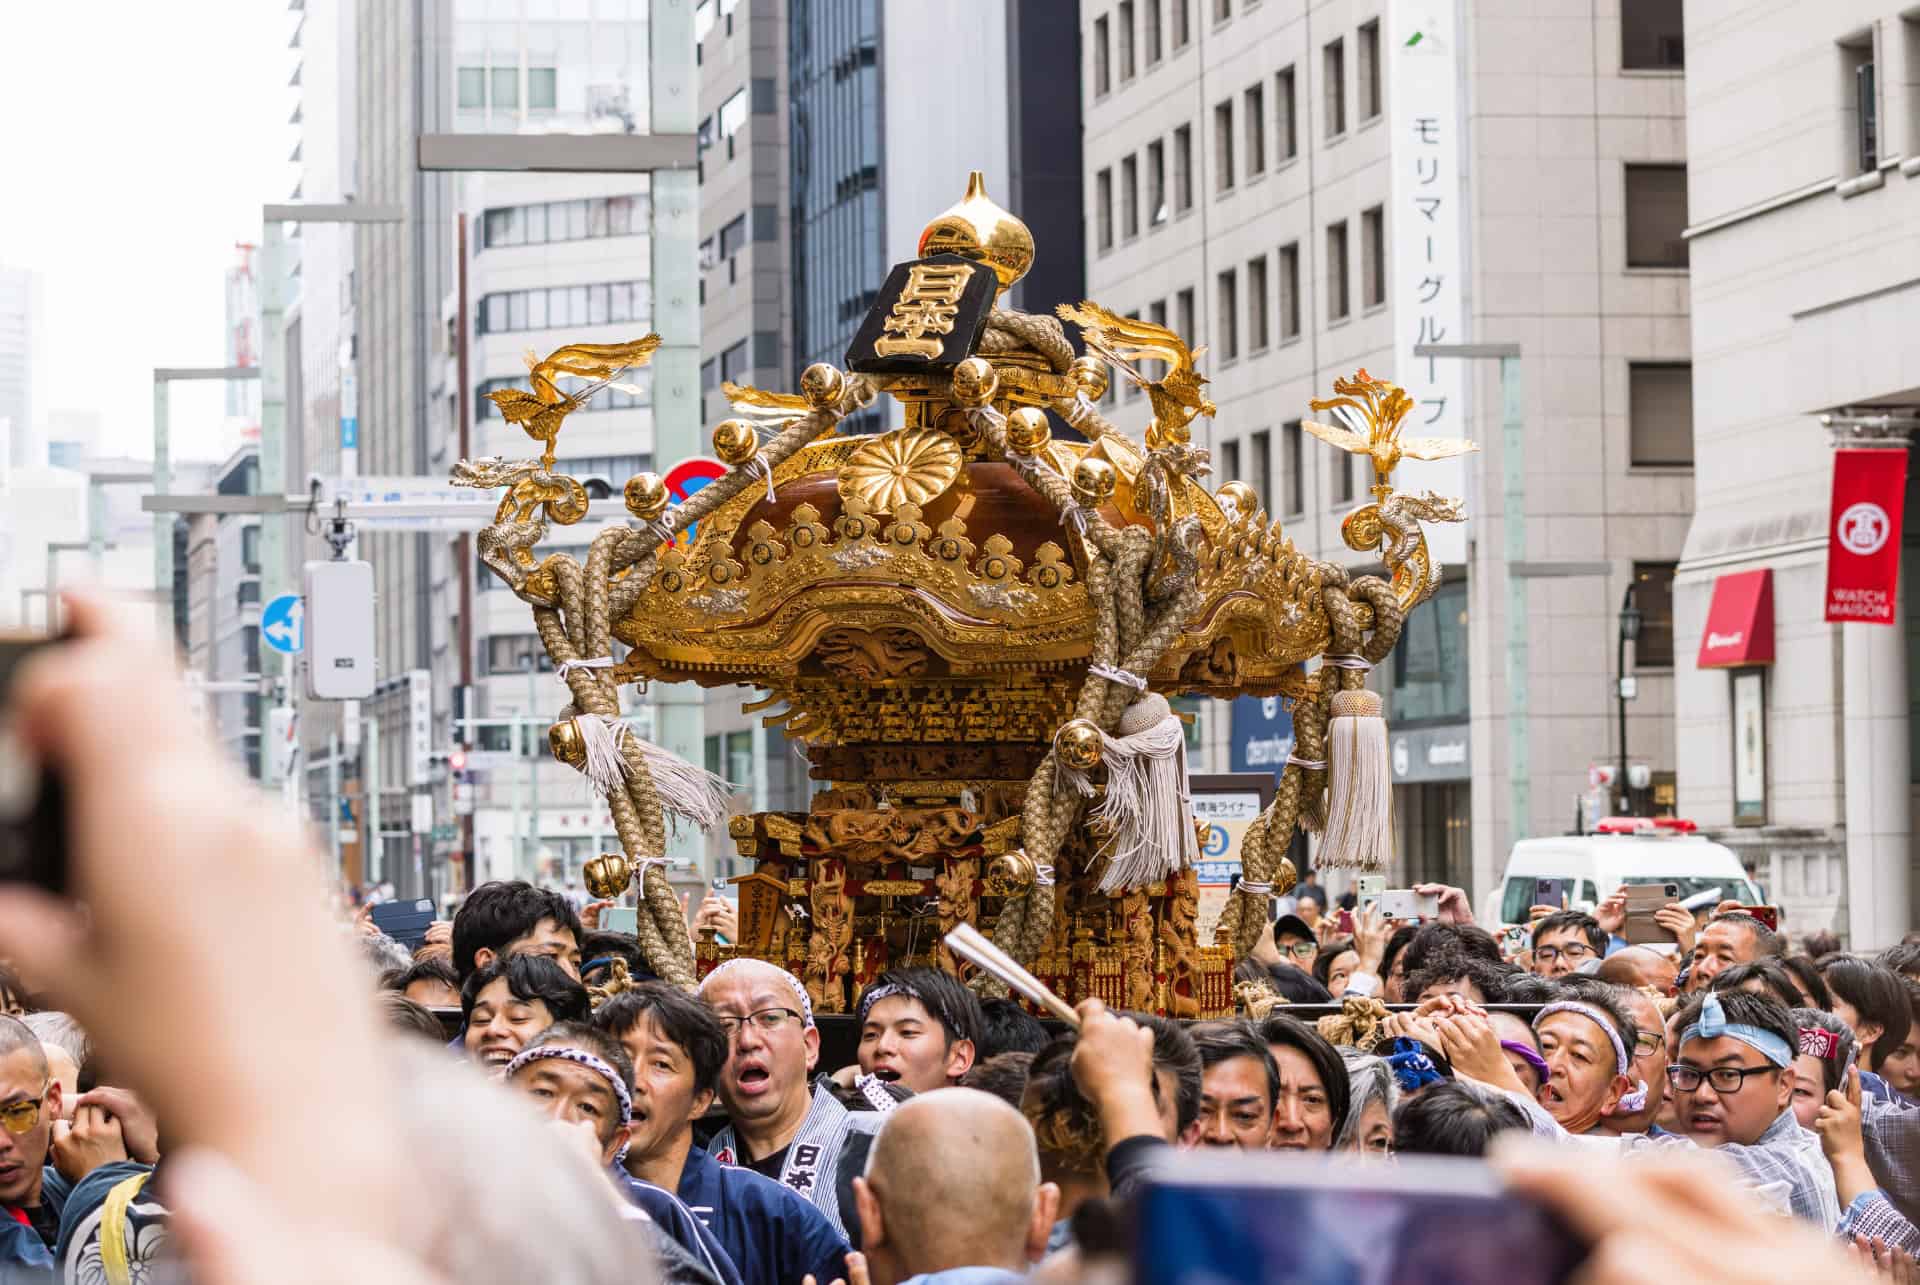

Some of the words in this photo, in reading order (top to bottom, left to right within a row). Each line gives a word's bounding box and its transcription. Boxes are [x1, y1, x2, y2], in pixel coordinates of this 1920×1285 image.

[1413, 118, 1447, 425] モリマーグループ
[1832, 588, 1887, 603] WATCH
[1828, 602, 1890, 617] MAISON
[1195, 801, 1256, 813] 晴海ライナー
